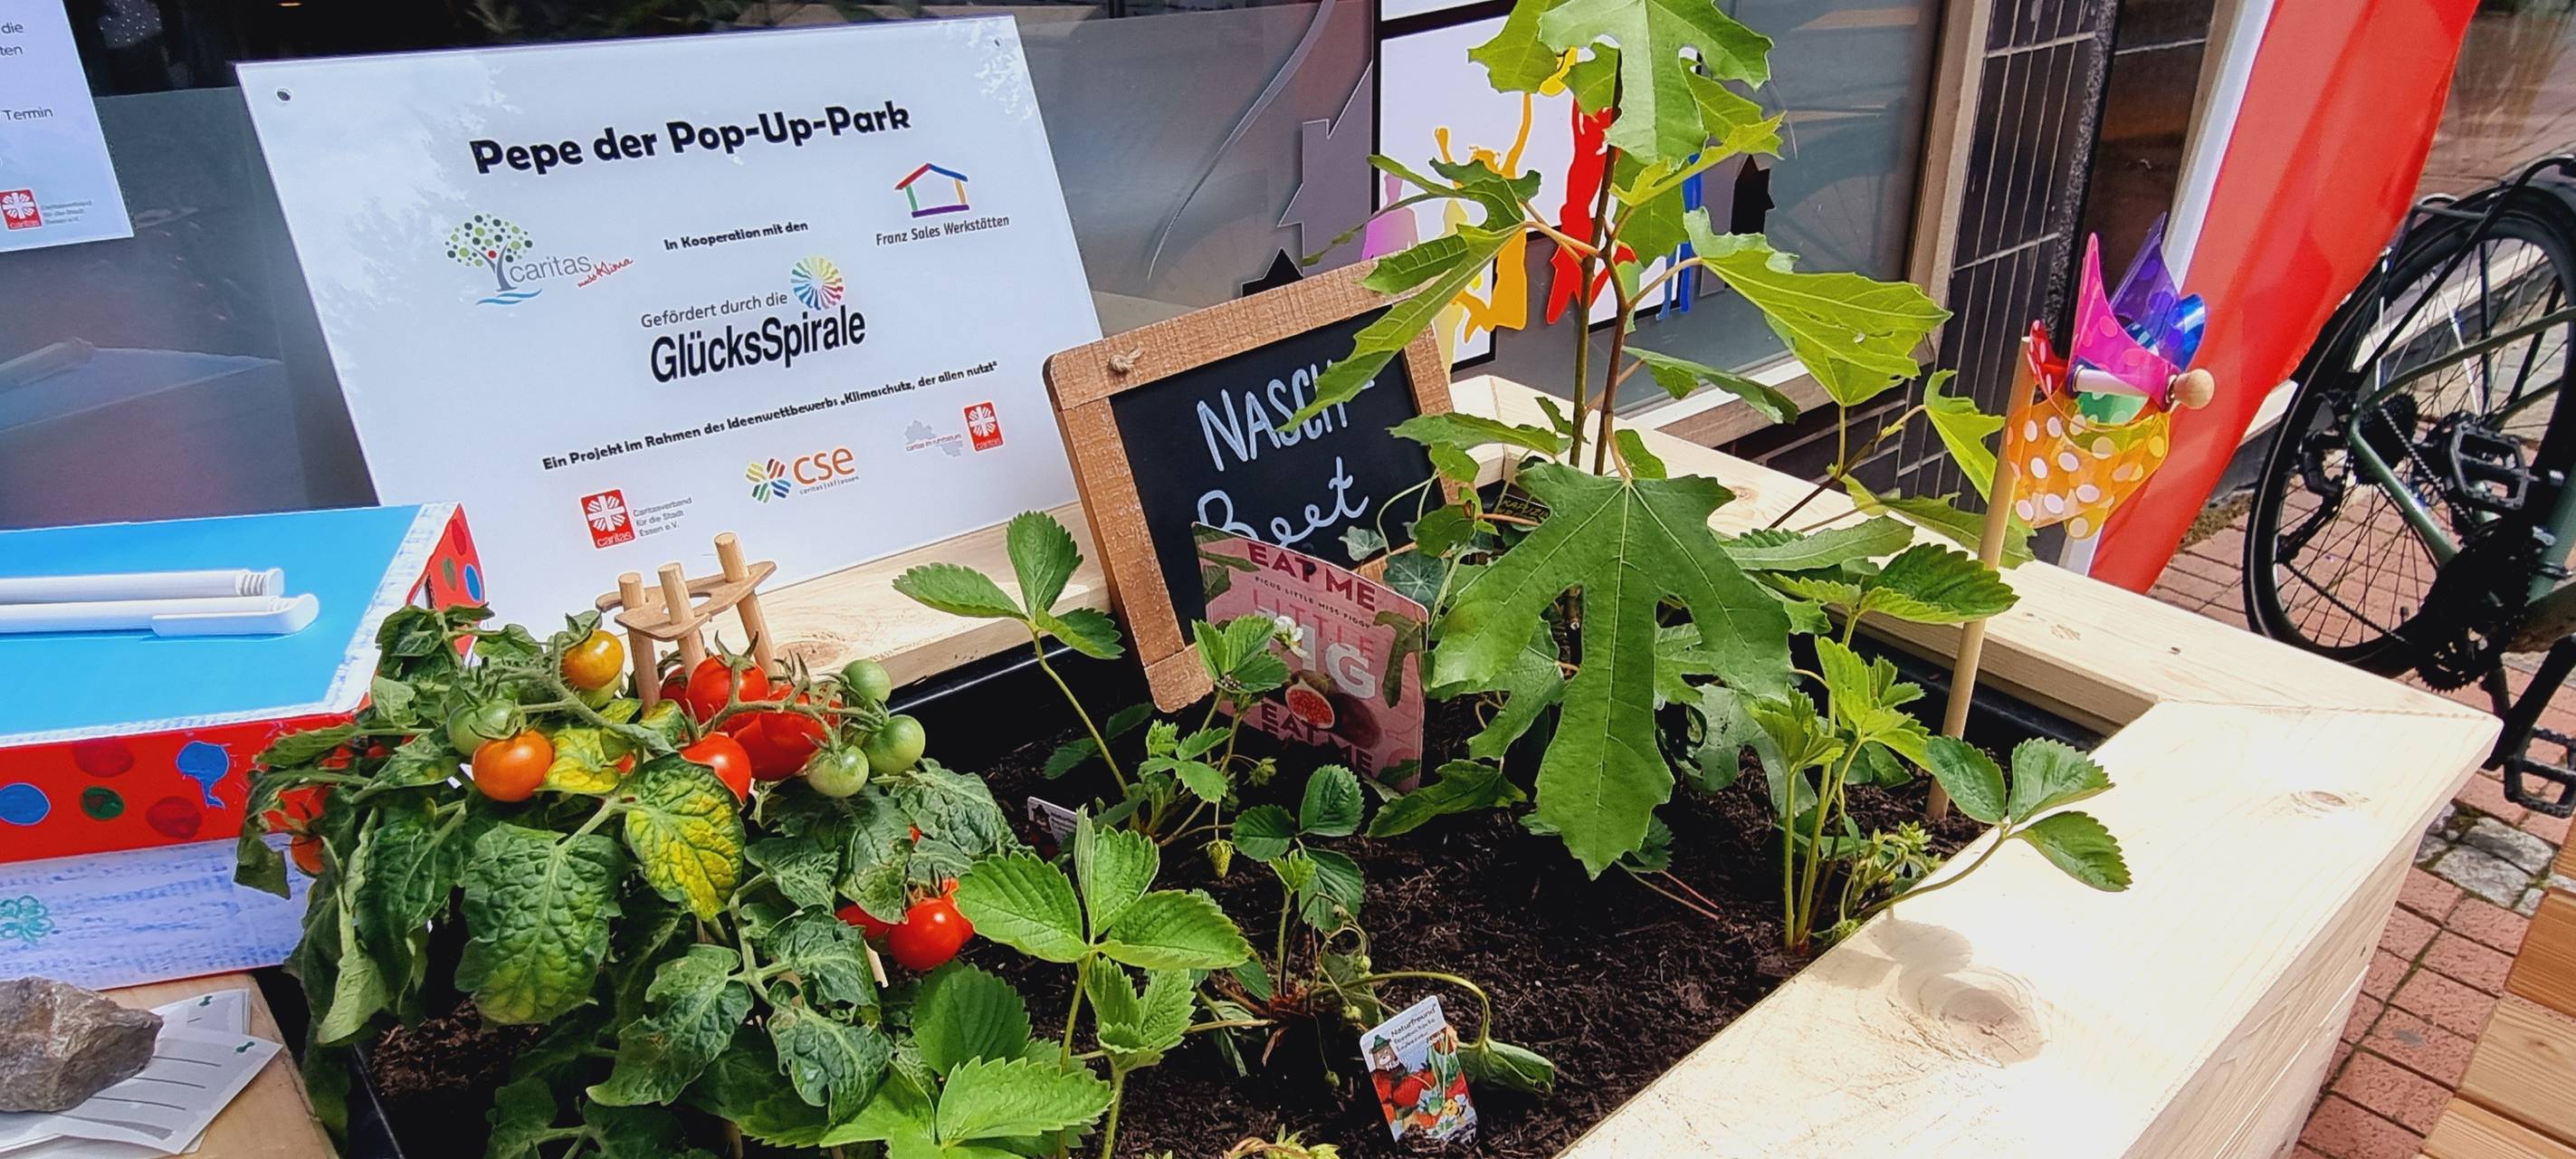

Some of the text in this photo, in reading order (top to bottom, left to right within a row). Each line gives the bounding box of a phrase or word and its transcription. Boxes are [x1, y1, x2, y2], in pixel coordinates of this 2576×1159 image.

[1, 22, 24, 34] die
[2, 107, 53, 121] Termin
[469, 101, 911, 175] Pepe der Pop-Up-Park
[663, 221, 808, 251] In Kooperation mit den
[875, 216, 1009, 246] Franz Sales Werkstätten
[510, 255, 592, 283] caritas
[594, 258, 634, 277] Klima
[641, 292, 787, 328] Gefördert durch die
[651, 304, 865, 383] GlücksSpirale
[542, 455, 568, 470] Ein
[568, 443, 625, 465] Projekt
[625, 439, 644, 453] im
[644, 427, 702, 447] Rahmen
[703, 422, 725, 436] des
[726, 398, 838, 430] Ideenwettbewerbs
[840, 380, 916, 407] „Klimaschutz,
[918, 375, 937, 388] der
[938, 369, 965, 384] allen
[793, 447, 855, 484] cse
[634, 497, 692, 517] Caritasverband
[663, 509, 684, 522] Stadt
[597, 531, 633, 547] caritas
[1247, 542, 1376, 612] EAT ME
[1285, 588, 1313, 604] LITTLE
[1318, 602, 1340, 616] MISS
[1343, 612, 1371, 629] FIGGY
[1261, 702, 1318, 747] EAT
